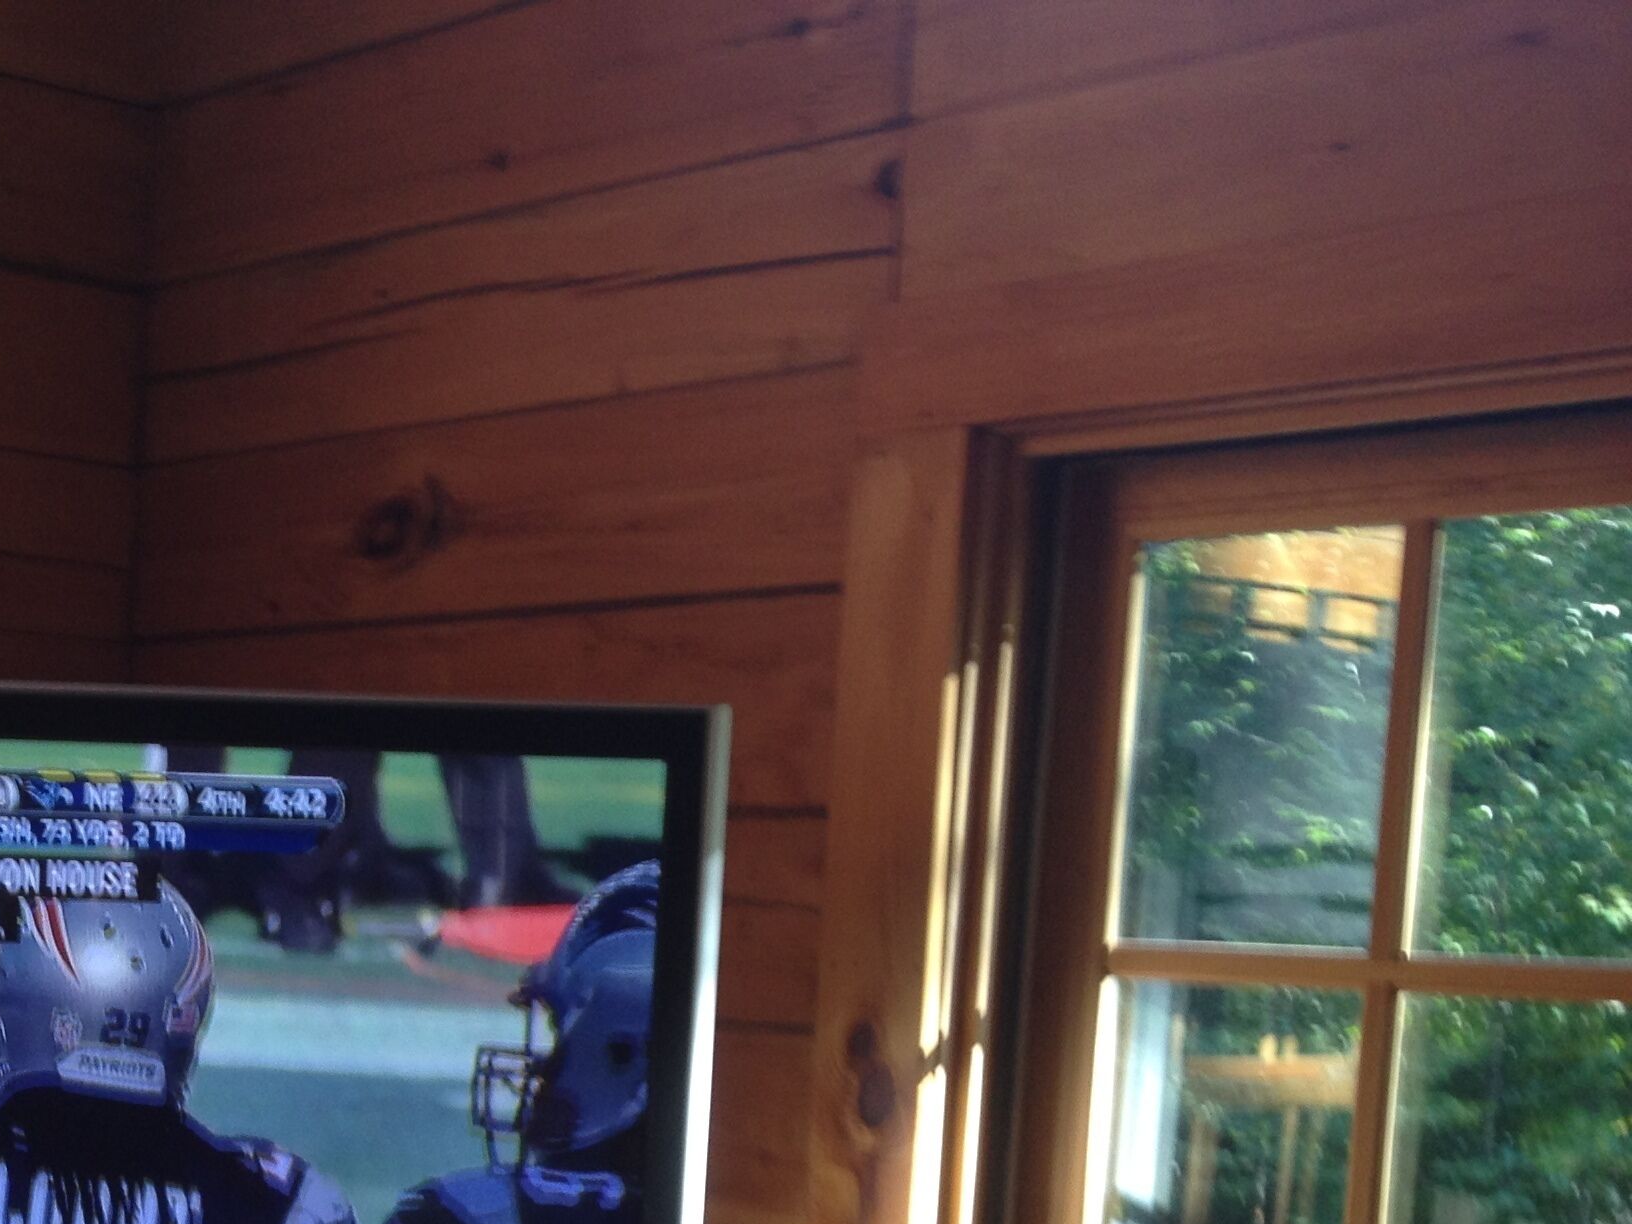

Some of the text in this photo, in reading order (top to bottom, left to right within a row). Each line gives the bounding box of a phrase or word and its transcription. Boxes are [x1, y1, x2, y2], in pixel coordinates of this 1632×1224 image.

[83, 781, 124, 813] NE
[196, 786, 247, 817] 4TH
[150, 820, 186, 851] TD
[46, 859, 139, 899] HOUSE
